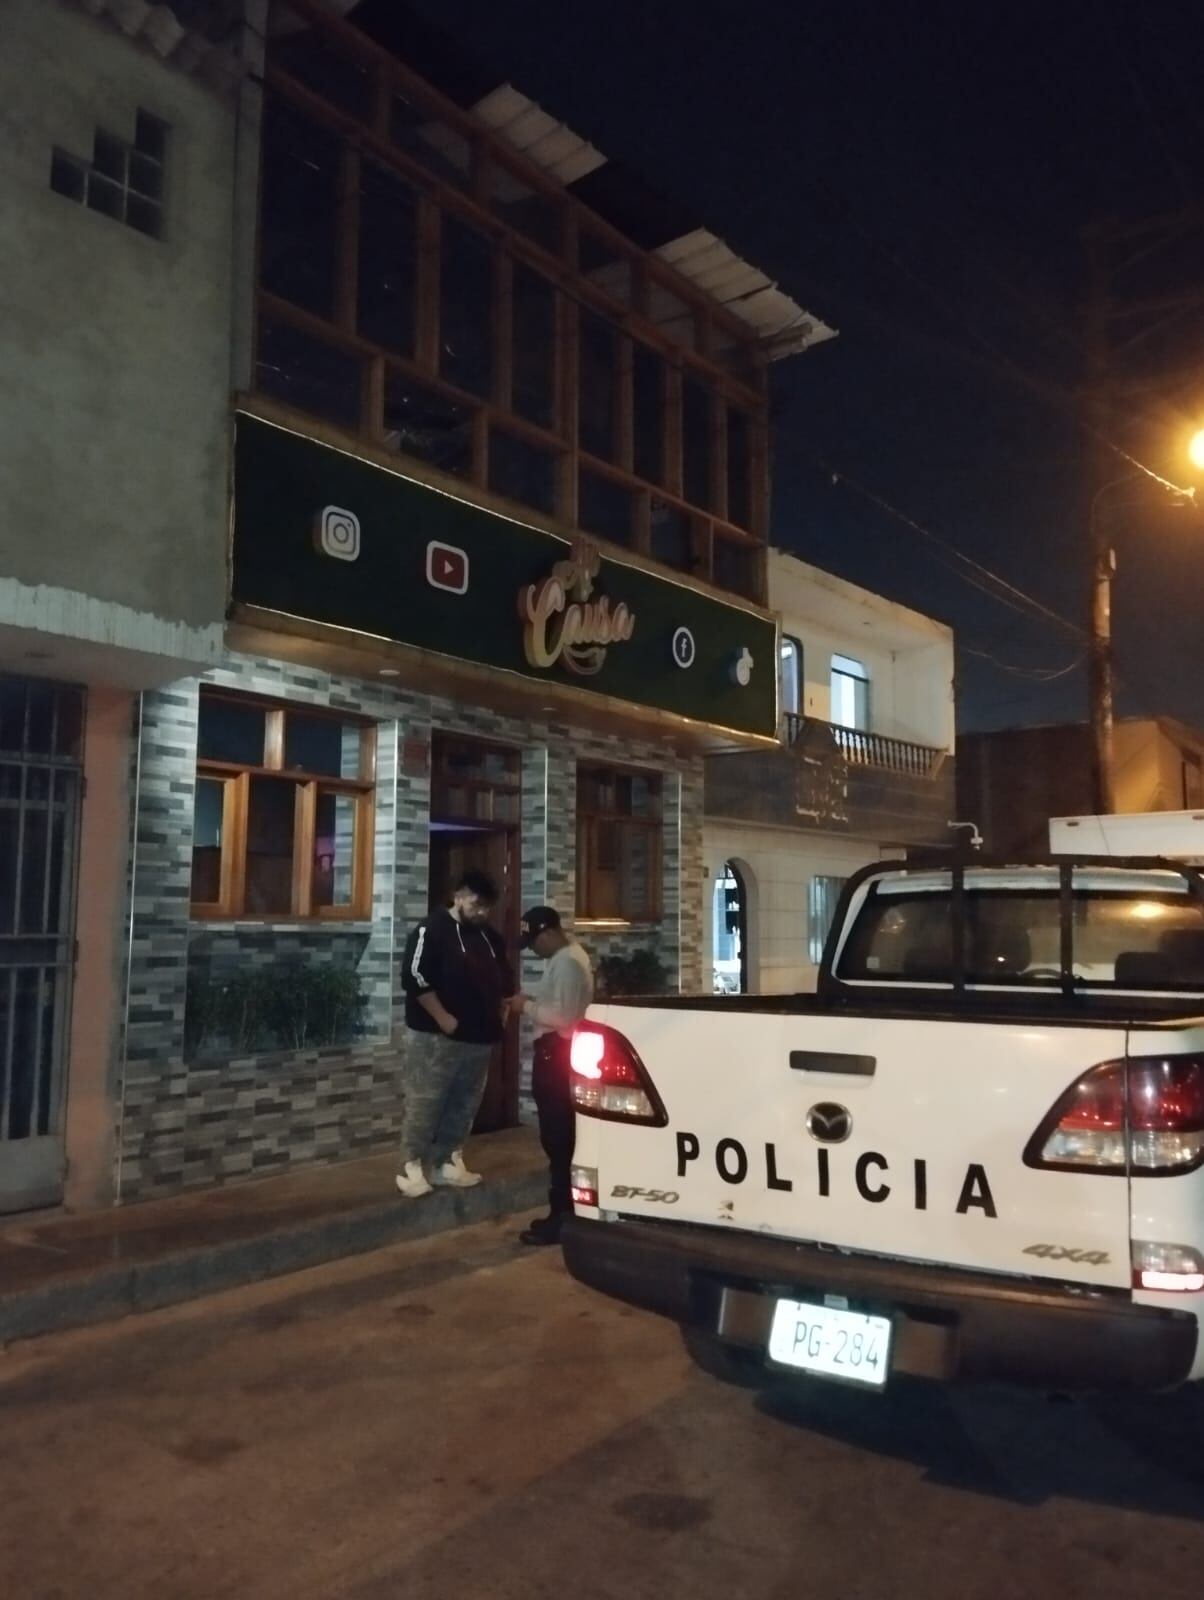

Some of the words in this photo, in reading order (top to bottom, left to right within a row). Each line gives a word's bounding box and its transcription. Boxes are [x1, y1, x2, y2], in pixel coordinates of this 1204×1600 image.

[610, 1184, 681, 1205] BT-50
[676, 1131, 998, 1219] POLICIA
[792, 1320, 880, 1372] PG-284
